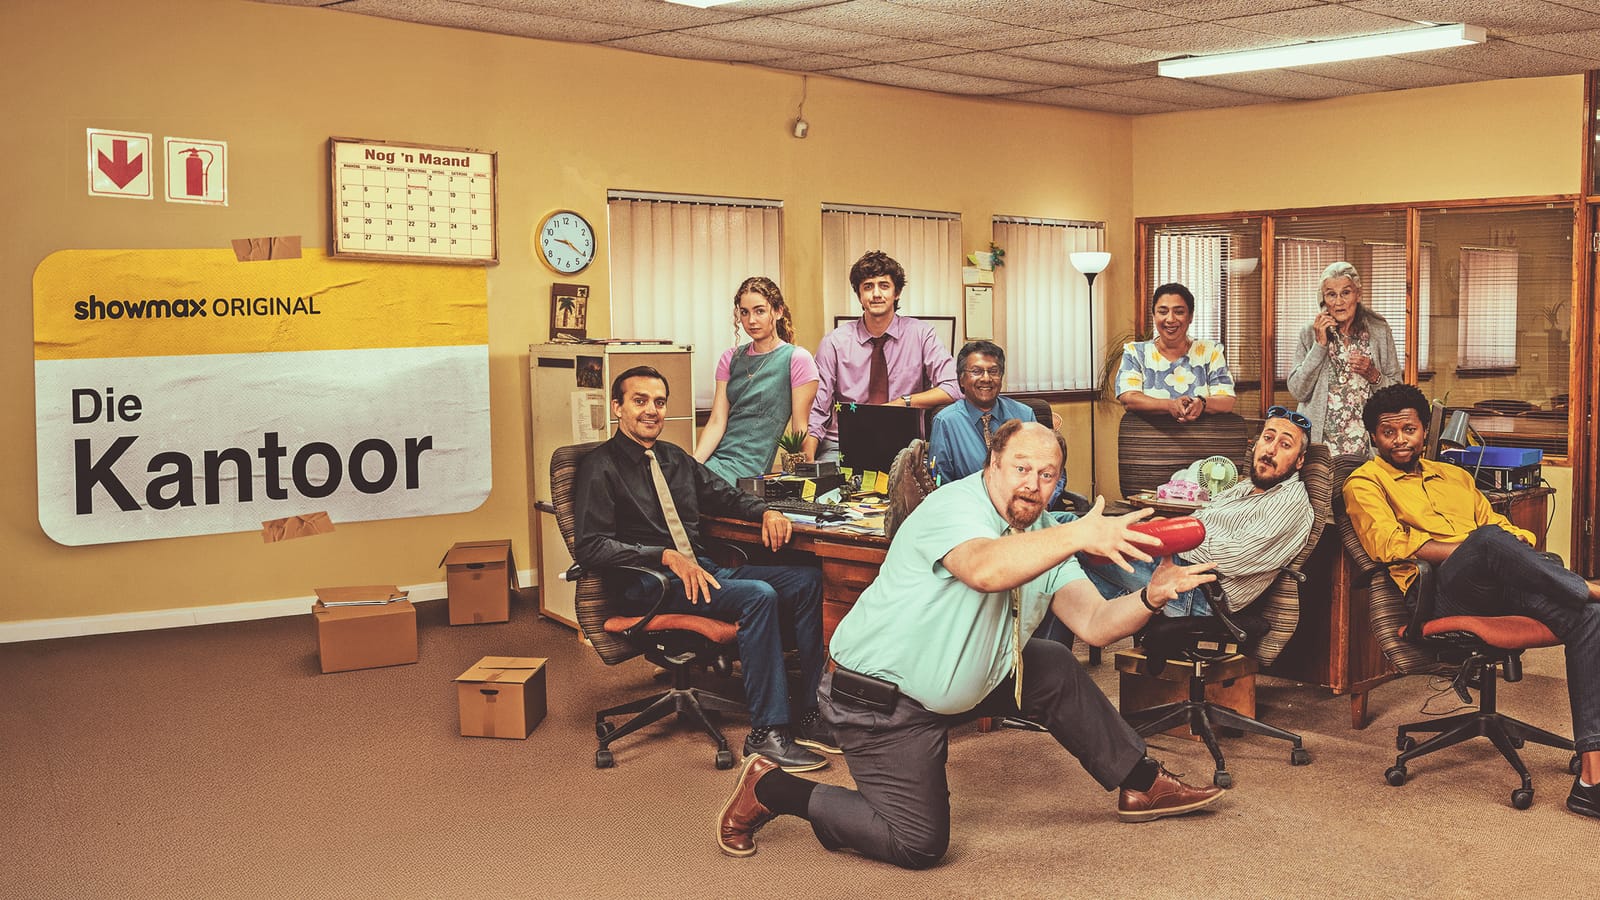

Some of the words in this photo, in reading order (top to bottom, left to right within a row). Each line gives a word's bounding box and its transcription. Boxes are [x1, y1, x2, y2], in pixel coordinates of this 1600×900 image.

[365, 149, 395, 164] Nog
[401, 153, 414, 163] 'n
[419, 153, 470, 167] Maand
[553, 220, 560, 228] 11
[562, 217, 569, 225] 12
[547, 228, 554, 236] 10
[581, 228, 586, 236] 2
[544, 238, 549, 246] 9
[585, 239, 590, 247] 3
[548, 249, 553, 258] 8
[557, 257, 562, 265] 7
[565, 260, 571, 268] 6
[575, 257, 580, 266] 5
[74, 295, 207, 320] showmax
[212, 296, 321, 317] ORIGINAL
[71, 387, 143, 425] Die
[74, 431, 433, 515] Kantoor
